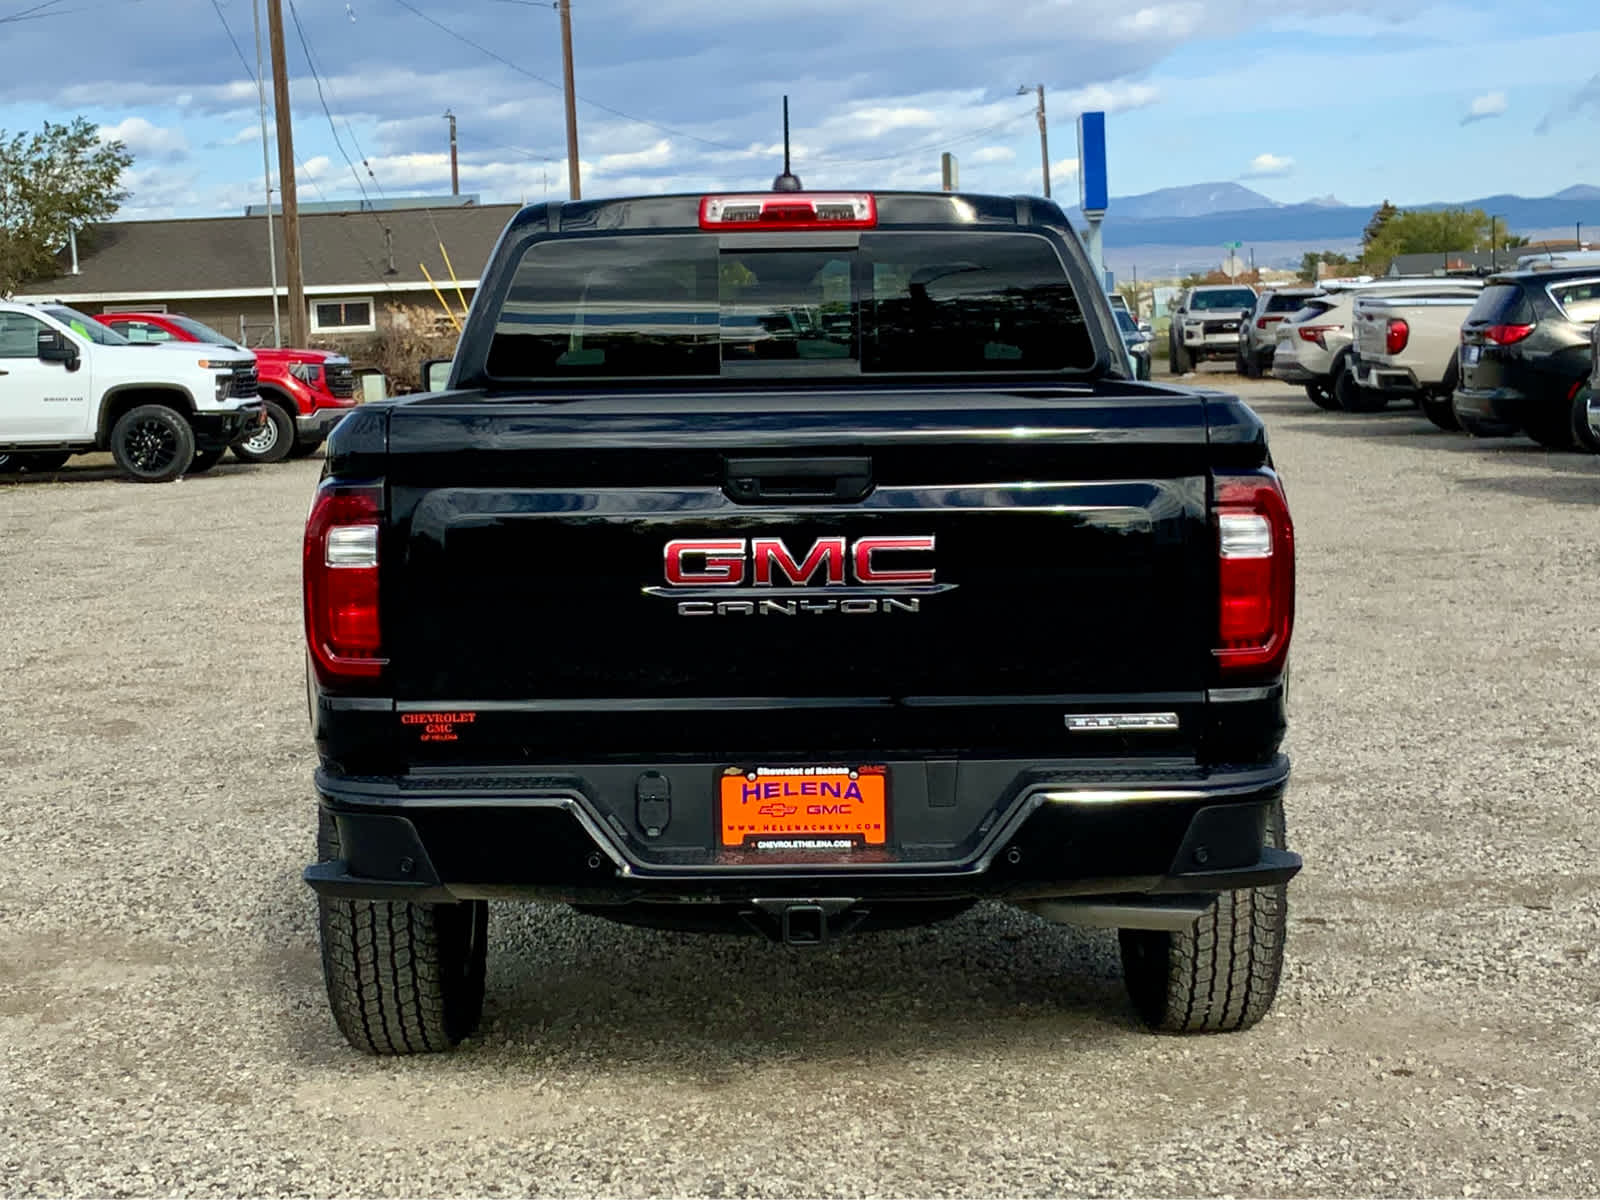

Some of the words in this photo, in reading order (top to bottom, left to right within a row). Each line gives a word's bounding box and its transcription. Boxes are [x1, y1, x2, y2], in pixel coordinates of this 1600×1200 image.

[664, 536, 936, 586] GMC
[678, 598, 919, 616] CANYON
[401, 712, 476, 724] CHEVROLET
[757, 767, 803, 776] Chevrolet
[804, 767, 814, 776] of
[742, 781, 864, 804] HELENA
[806, 804, 852, 815] GMC
[757, 839, 851, 849] CHEVROLETHELENA.COM
